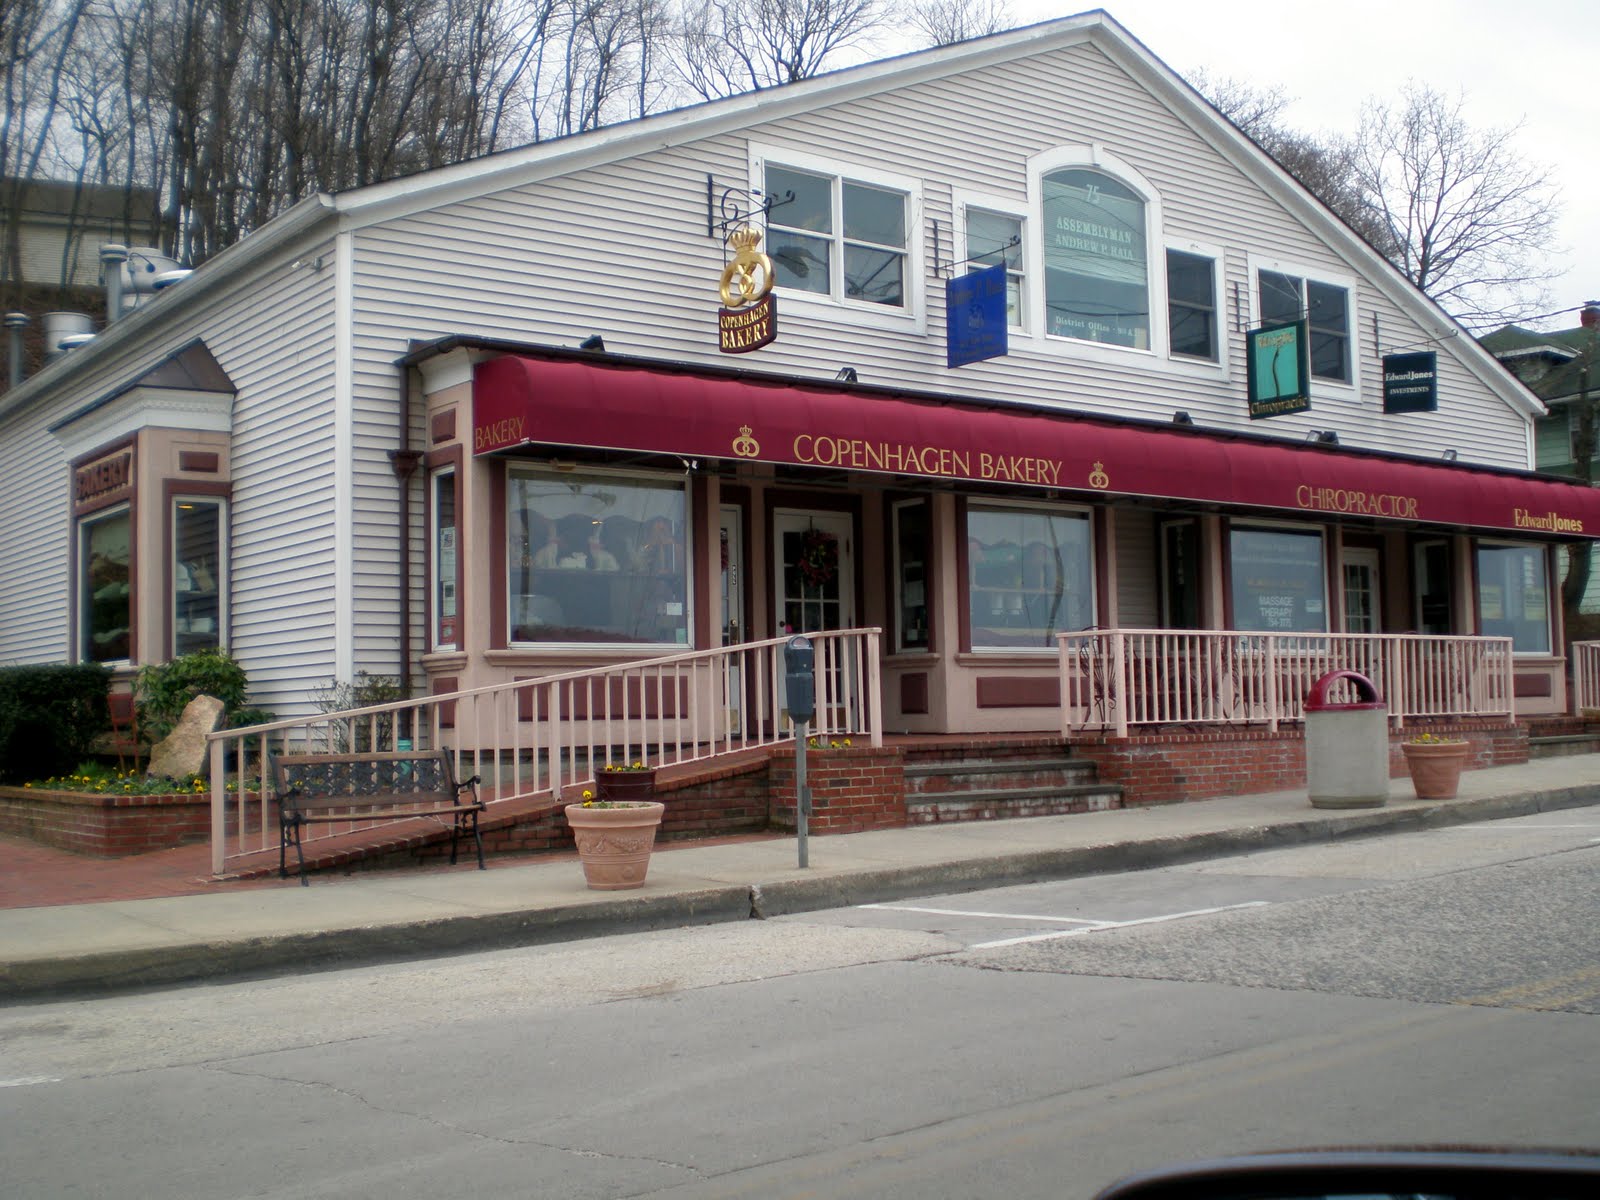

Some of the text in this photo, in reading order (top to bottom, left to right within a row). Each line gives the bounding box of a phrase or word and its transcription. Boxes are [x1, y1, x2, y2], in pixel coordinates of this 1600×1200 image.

[1086, 183, 1100, 204] 75
[1055, 234, 1098, 252] ANDREW
[1056, 216, 1132, 244] ASSEMBLYMAN
[720, 301, 770, 329] COPENHAGEN
[1055, 316, 1085, 328] District
[721, 316, 770, 348] BAKERY
[1389, 386, 1430, 395] INVESTMENTS
[475, 416, 526, 449] BAKERY
[793, 434, 1063, 485] COPENHAGEN BAKERY
[76, 452, 132, 500] BAKERY
[1296, 485, 1419, 519] CHIROPRACTOR
[1258, 595, 1294, 606] MASSAGE
[1259, 607, 1293, 617] THERAPY
